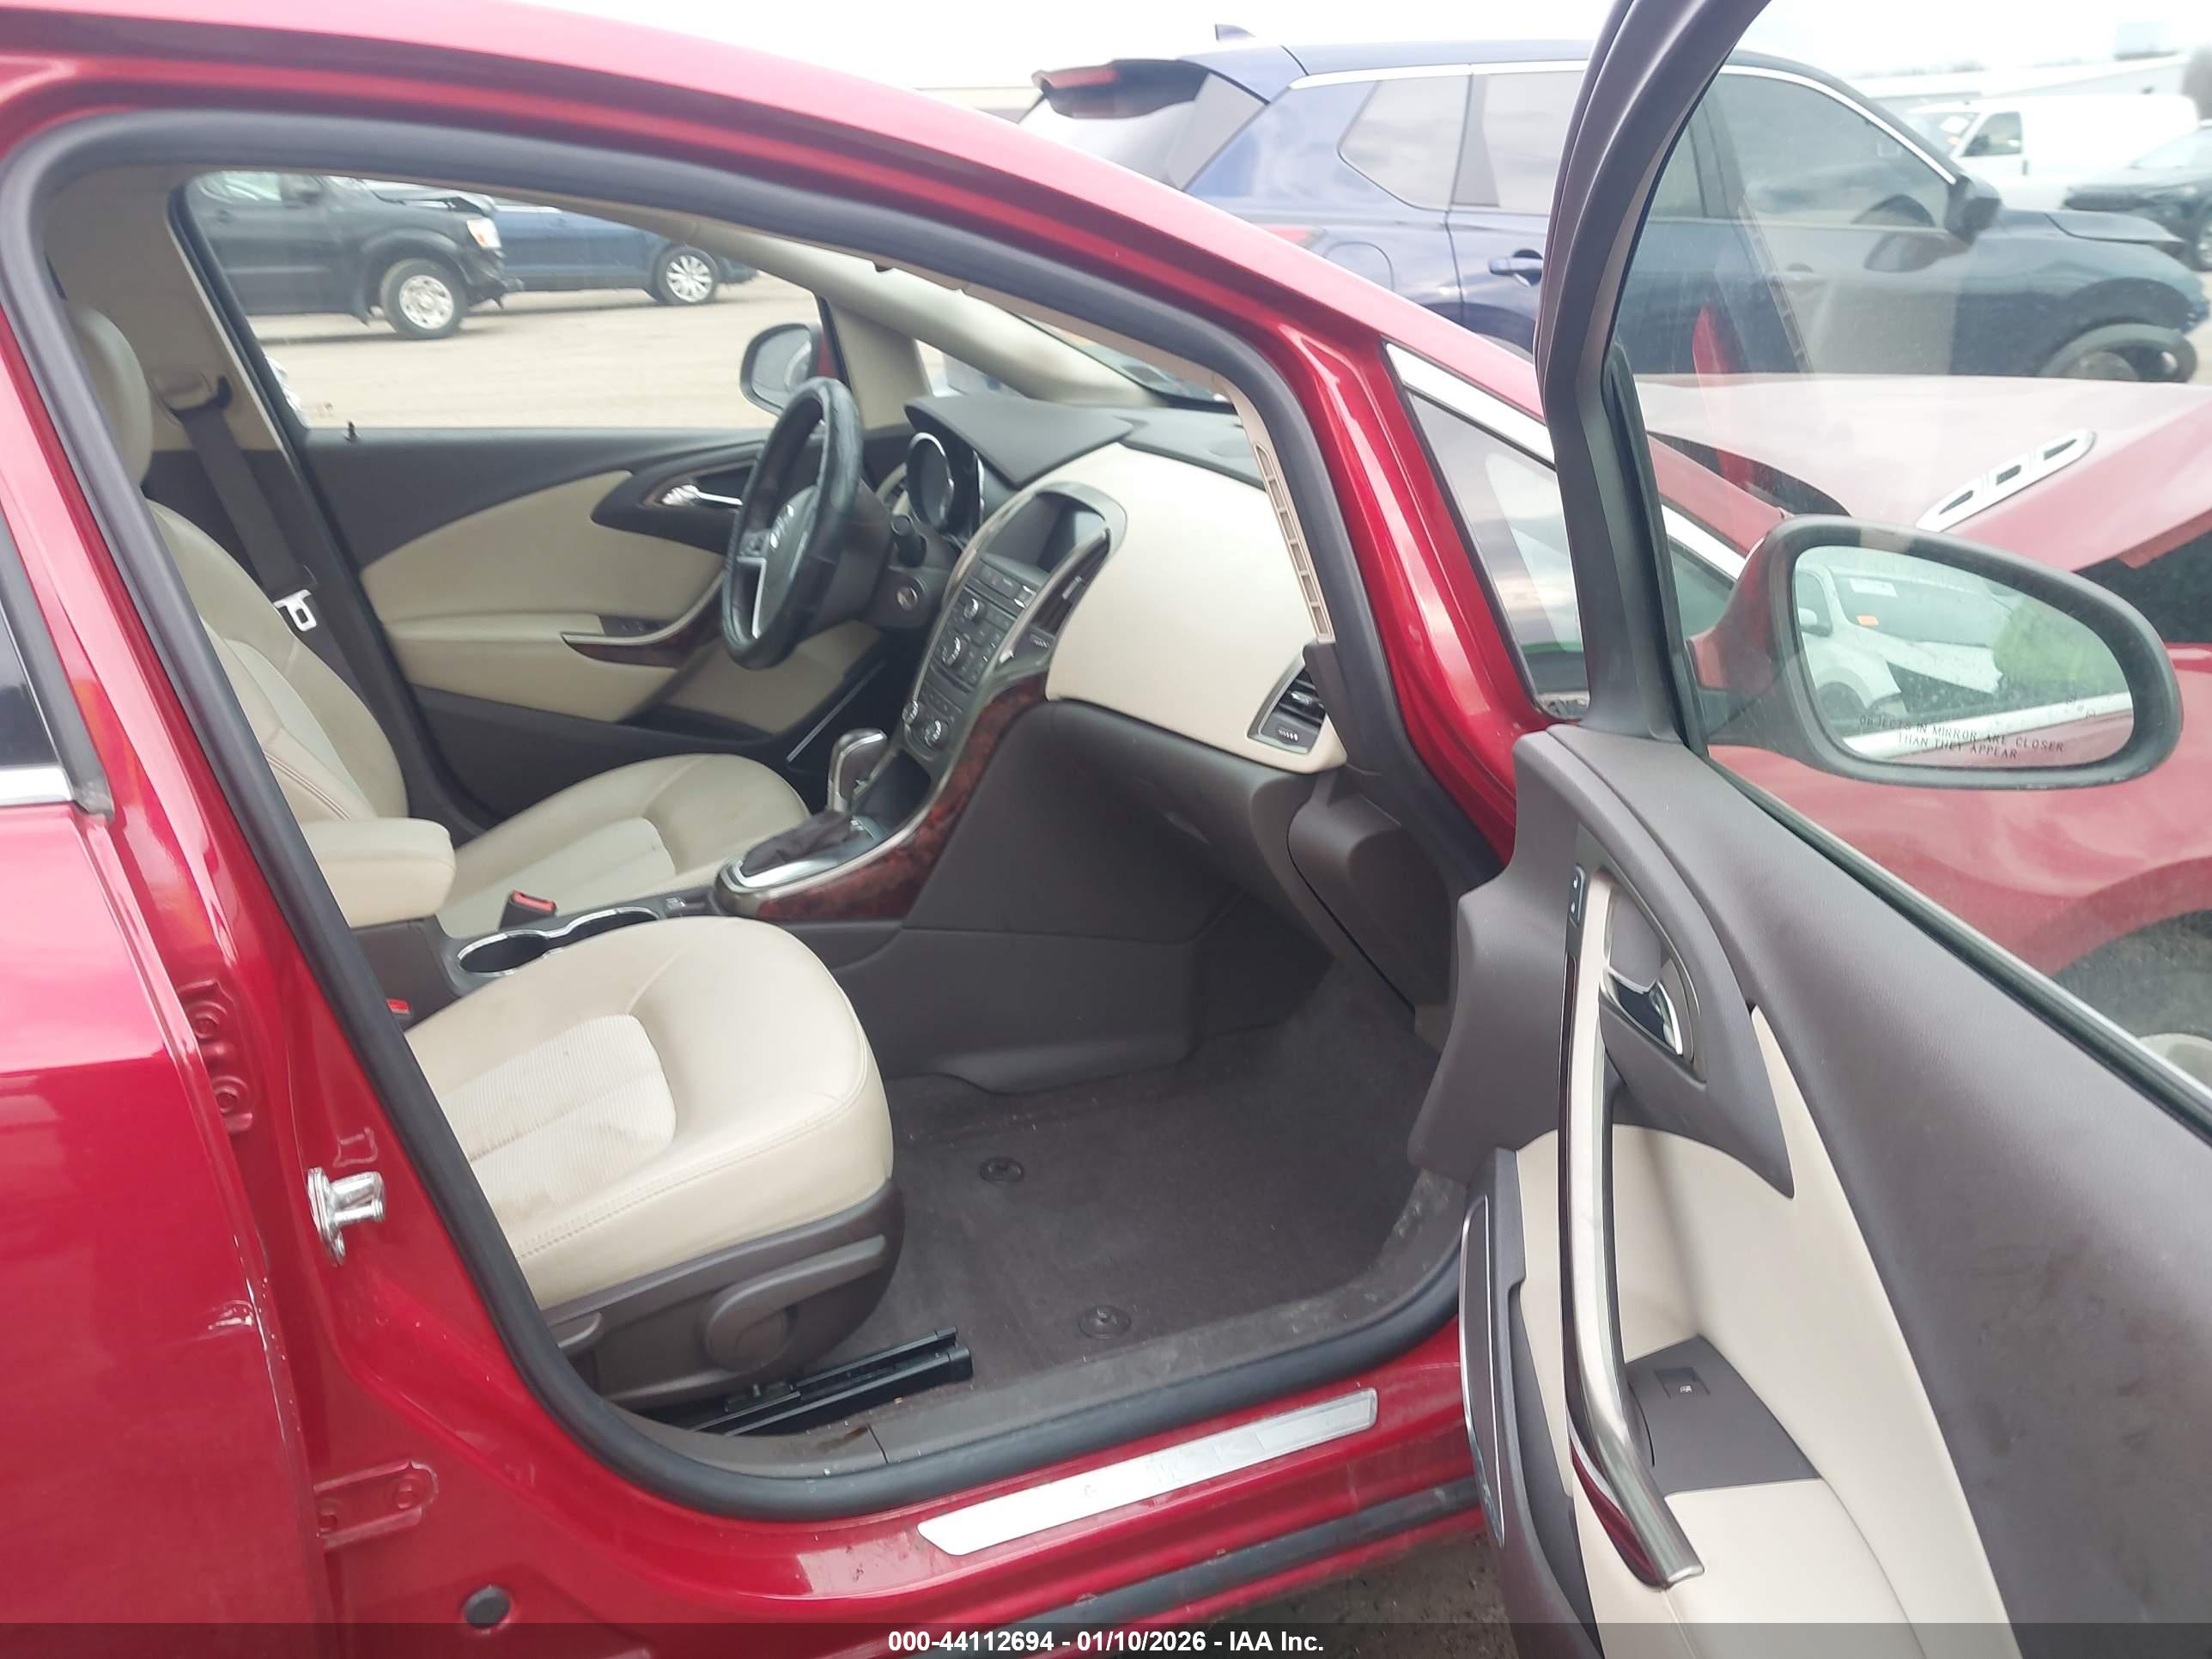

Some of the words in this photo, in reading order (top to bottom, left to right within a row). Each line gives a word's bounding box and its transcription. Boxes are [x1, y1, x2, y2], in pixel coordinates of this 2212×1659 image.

[1898, 732, 1929, 748] THAN
[1935, 739, 1962, 751] THEY
[1971, 742, 2017, 759] APPEAR
[1917, 722, 1928, 733] IN
[1933, 725, 1977, 742] MIRROR
[1987, 734, 2006, 744] ARE
[2015, 737, 2063, 753] CLOSER
